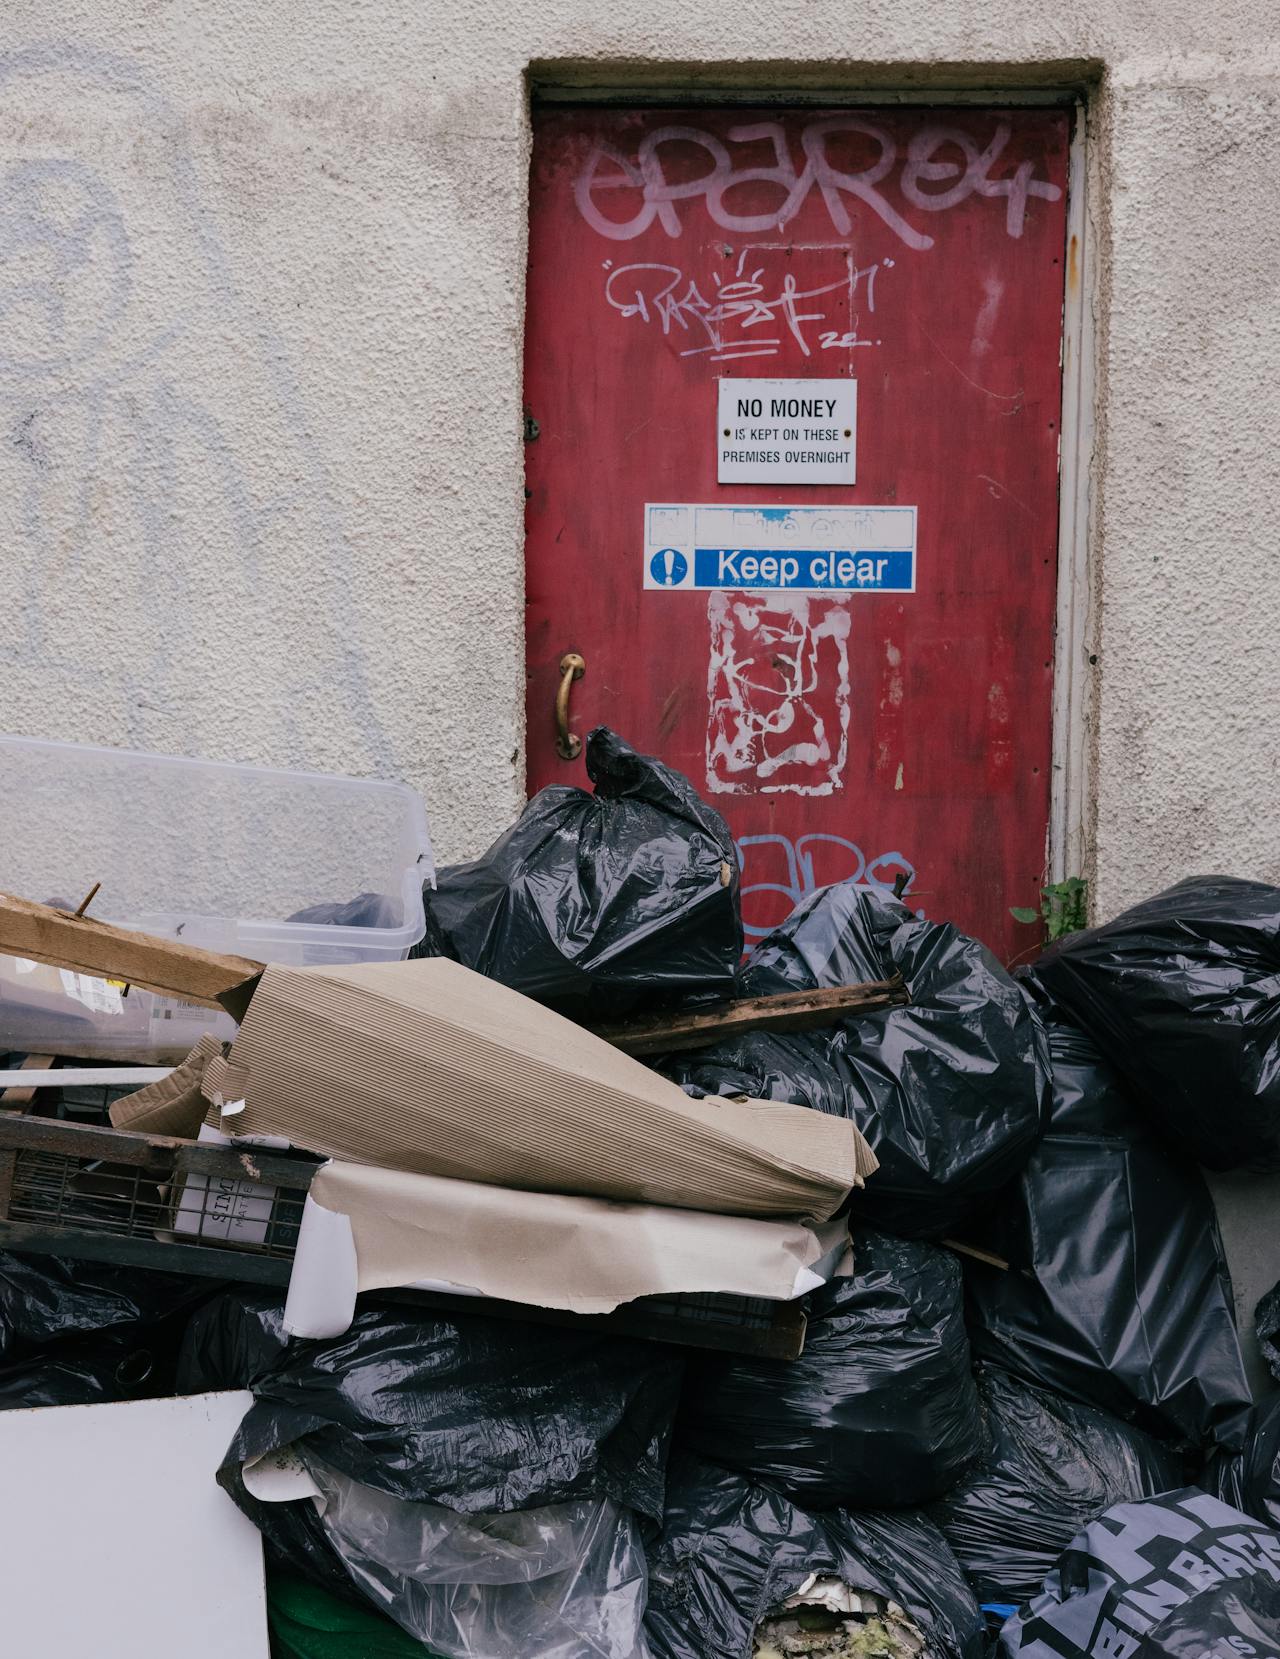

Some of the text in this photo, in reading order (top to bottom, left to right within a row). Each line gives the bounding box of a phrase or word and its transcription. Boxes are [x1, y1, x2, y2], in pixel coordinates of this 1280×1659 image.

[737, 399, 837, 418] NO MONEY
[735, 428, 839, 442] IS KEPT ON THESE
[723, 451, 851, 464] PREMISES OVERNIGHT
[718, 551, 889, 586] Keep clear
[1090, 1579, 1190, 1659] BIN
